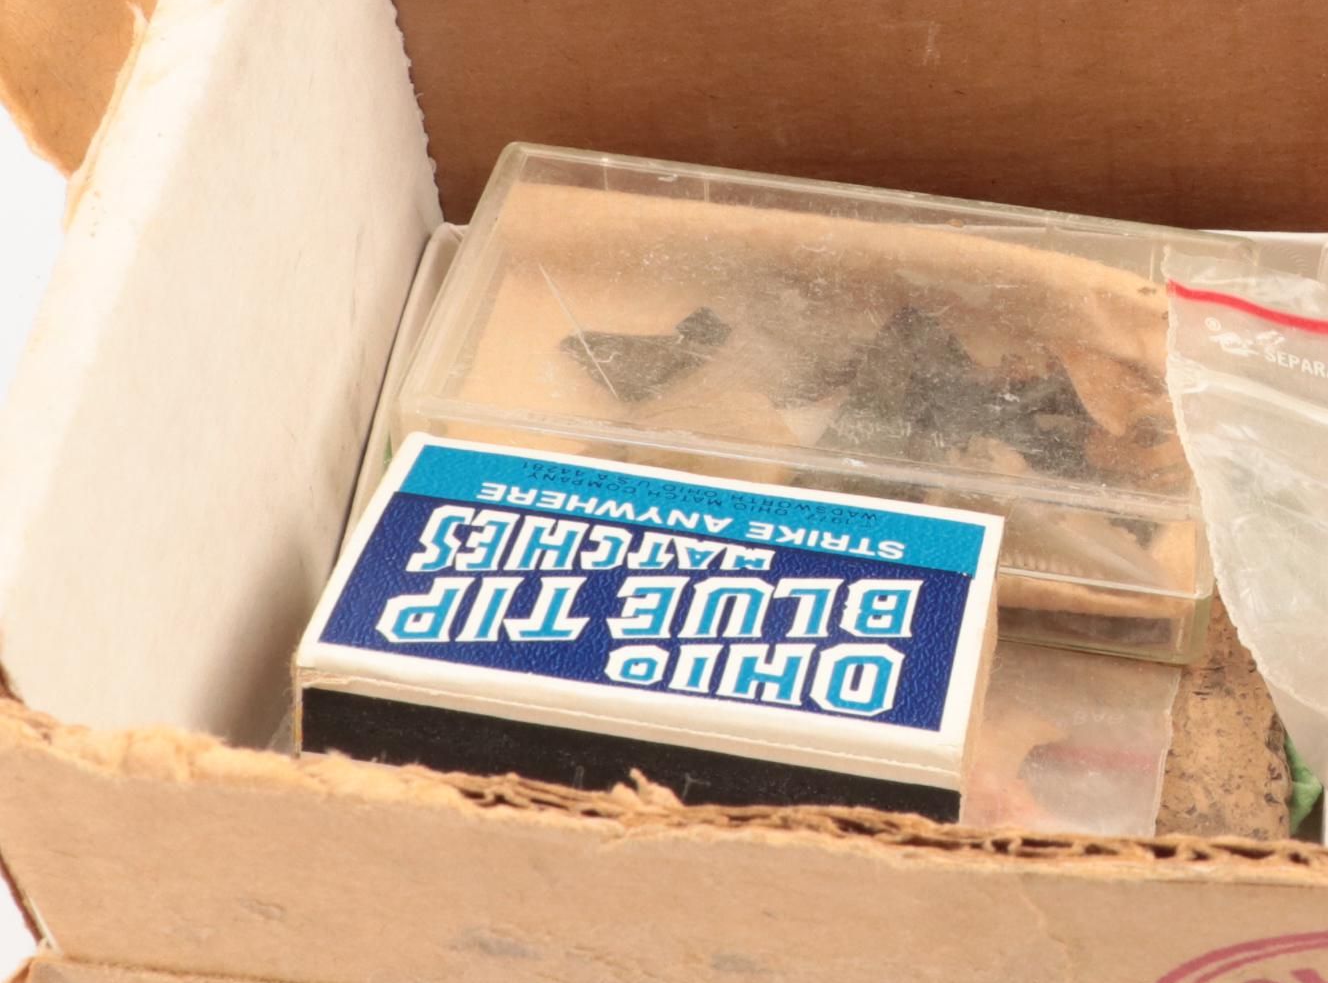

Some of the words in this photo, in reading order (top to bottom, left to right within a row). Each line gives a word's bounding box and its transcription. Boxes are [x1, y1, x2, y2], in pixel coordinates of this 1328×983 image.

[528, 471, 637, 495] COMPANY
[647, 489, 724, 508] MATCH
[662, 484, 716, 498] OHIO
[476, 481, 734, 533] ANYWHERE
[730, 493, 878, 521] WADSWORTH
[733, 502, 789, 517] OHIO
[406, 505, 776, 572] MATCHES
[745, 520, 907, 560] STRIKE
[376, 576, 591, 644] TIP
[605, 576, 925, 639] BLUE
[605, 642, 906, 717] OHIO
